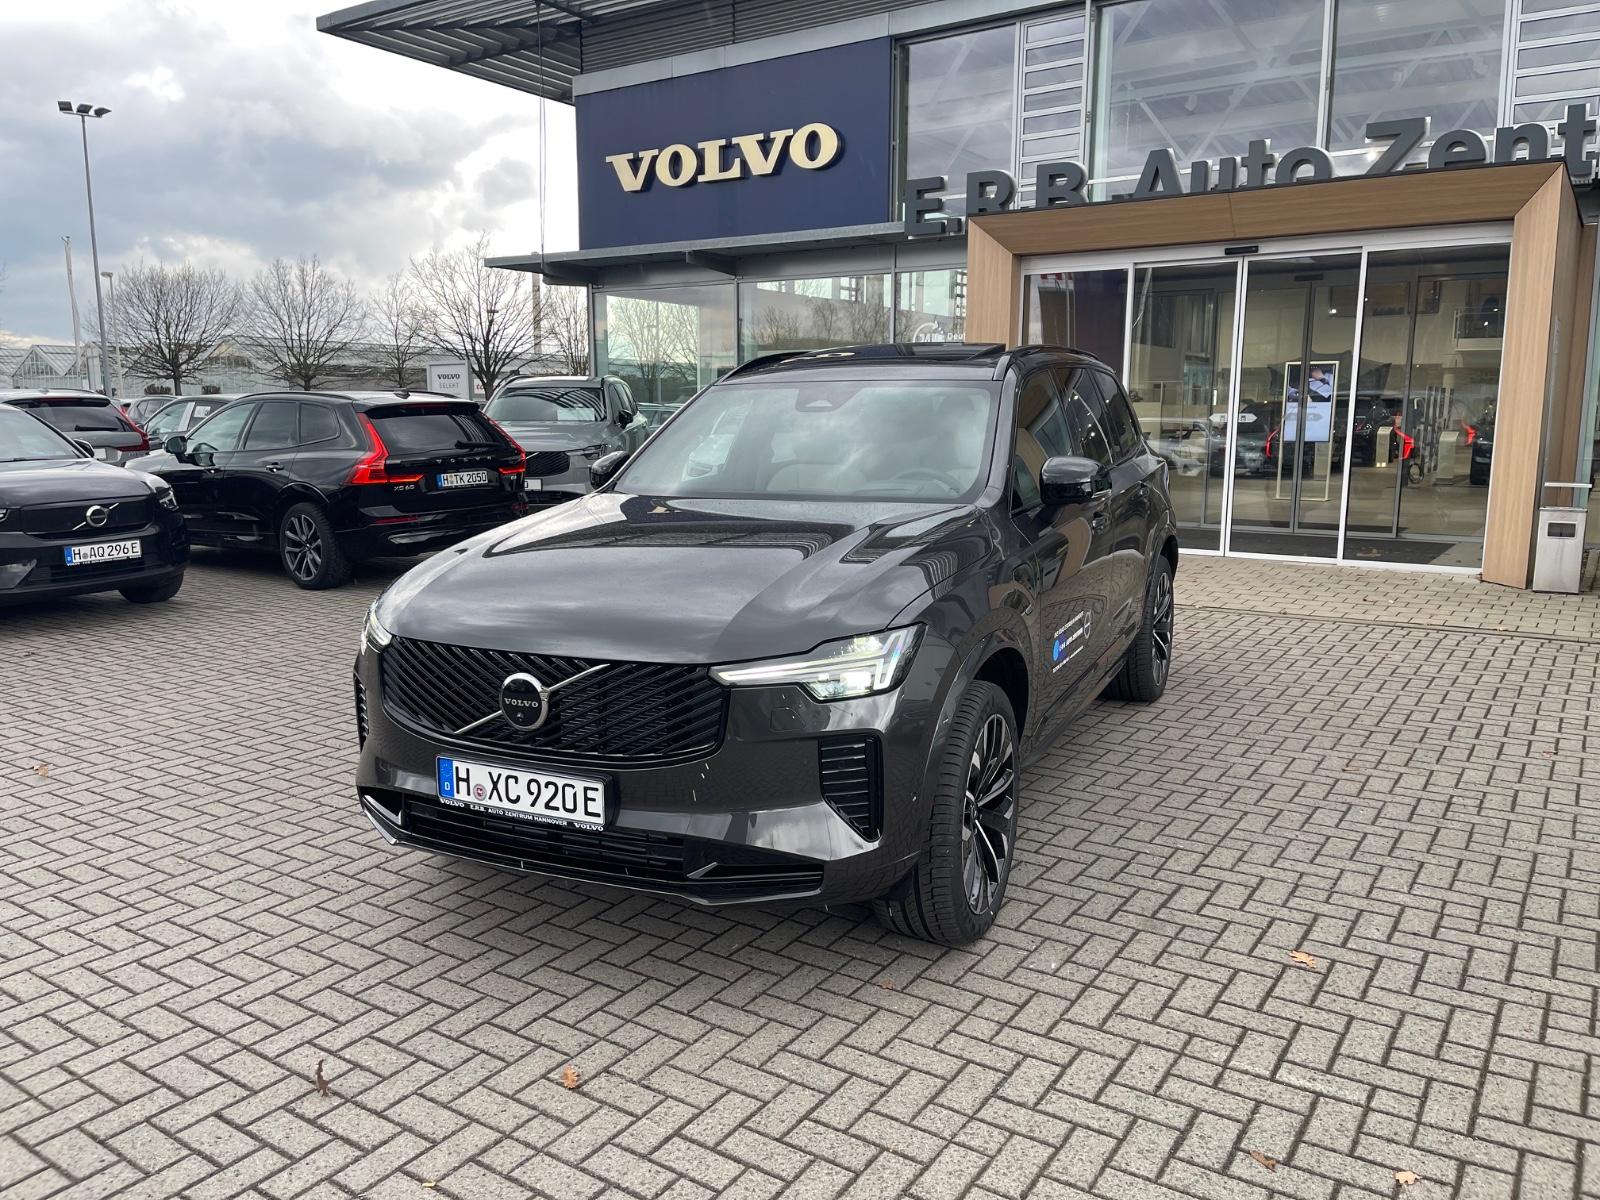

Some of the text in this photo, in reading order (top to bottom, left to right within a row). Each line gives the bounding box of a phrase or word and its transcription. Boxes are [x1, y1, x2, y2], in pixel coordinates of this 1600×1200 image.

[606, 122, 841, 192] VOLVO
[1133, 138, 1335, 195] Auto
[454, 474, 466, 485] TK
[466, 472, 487, 484] 2050
[72, 548, 82, 560] H
[89, 546, 106, 559] AQ
[504, 697, 539, 708] VOLVO
[454, 766, 471, 796] H
[488, 771, 521, 804] XC
[439, 797, 465, 808] VOLVO
[488, 807, 504, 816] AUTO
[573, 821, 604, 832] VOLVO
